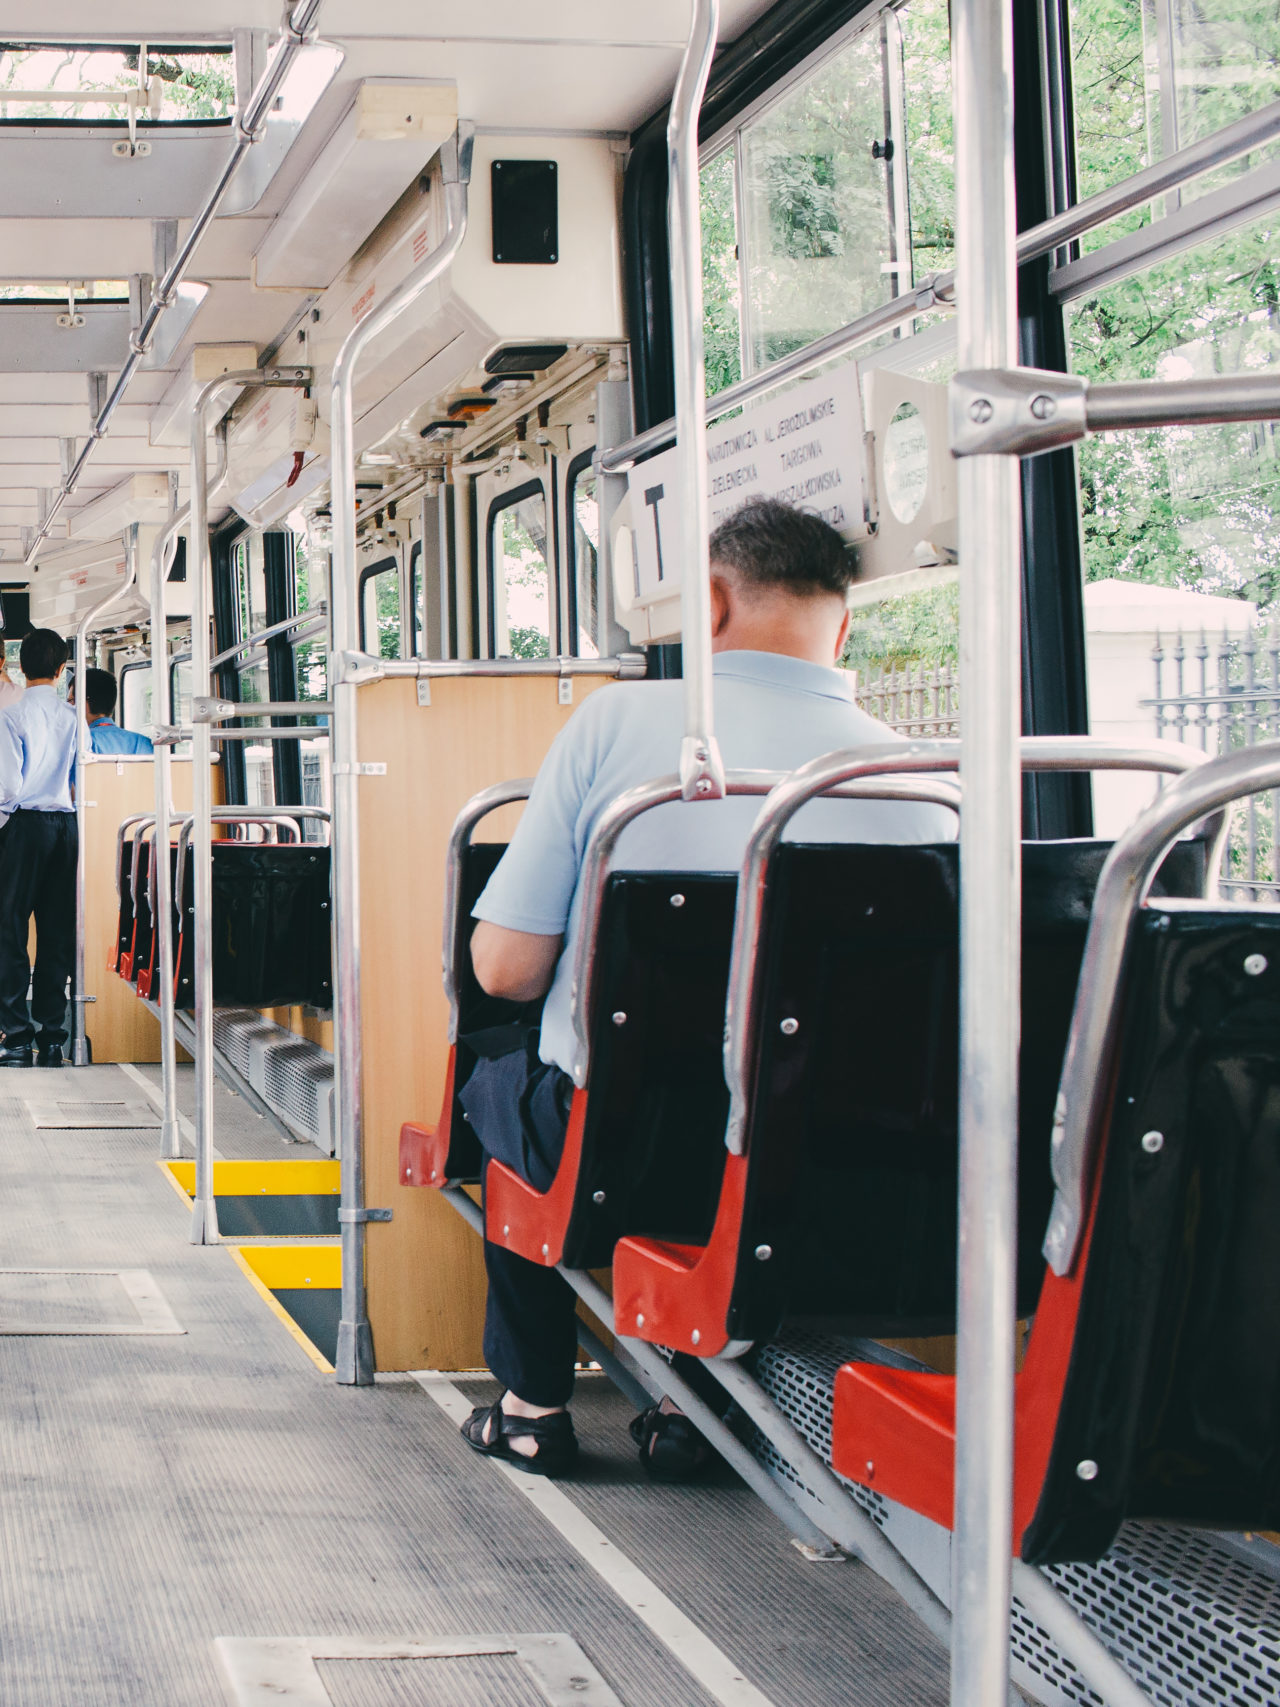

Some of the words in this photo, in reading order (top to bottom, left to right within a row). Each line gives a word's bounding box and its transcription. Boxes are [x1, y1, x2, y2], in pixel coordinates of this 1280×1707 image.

[706, 428, 758, 465] NARUTOWICZA
[777, 397, 835, 439] JEROZOLIMSKIE
[780, 439, 823, 472] TARGOWA
[644, 483, 664, 581] T
